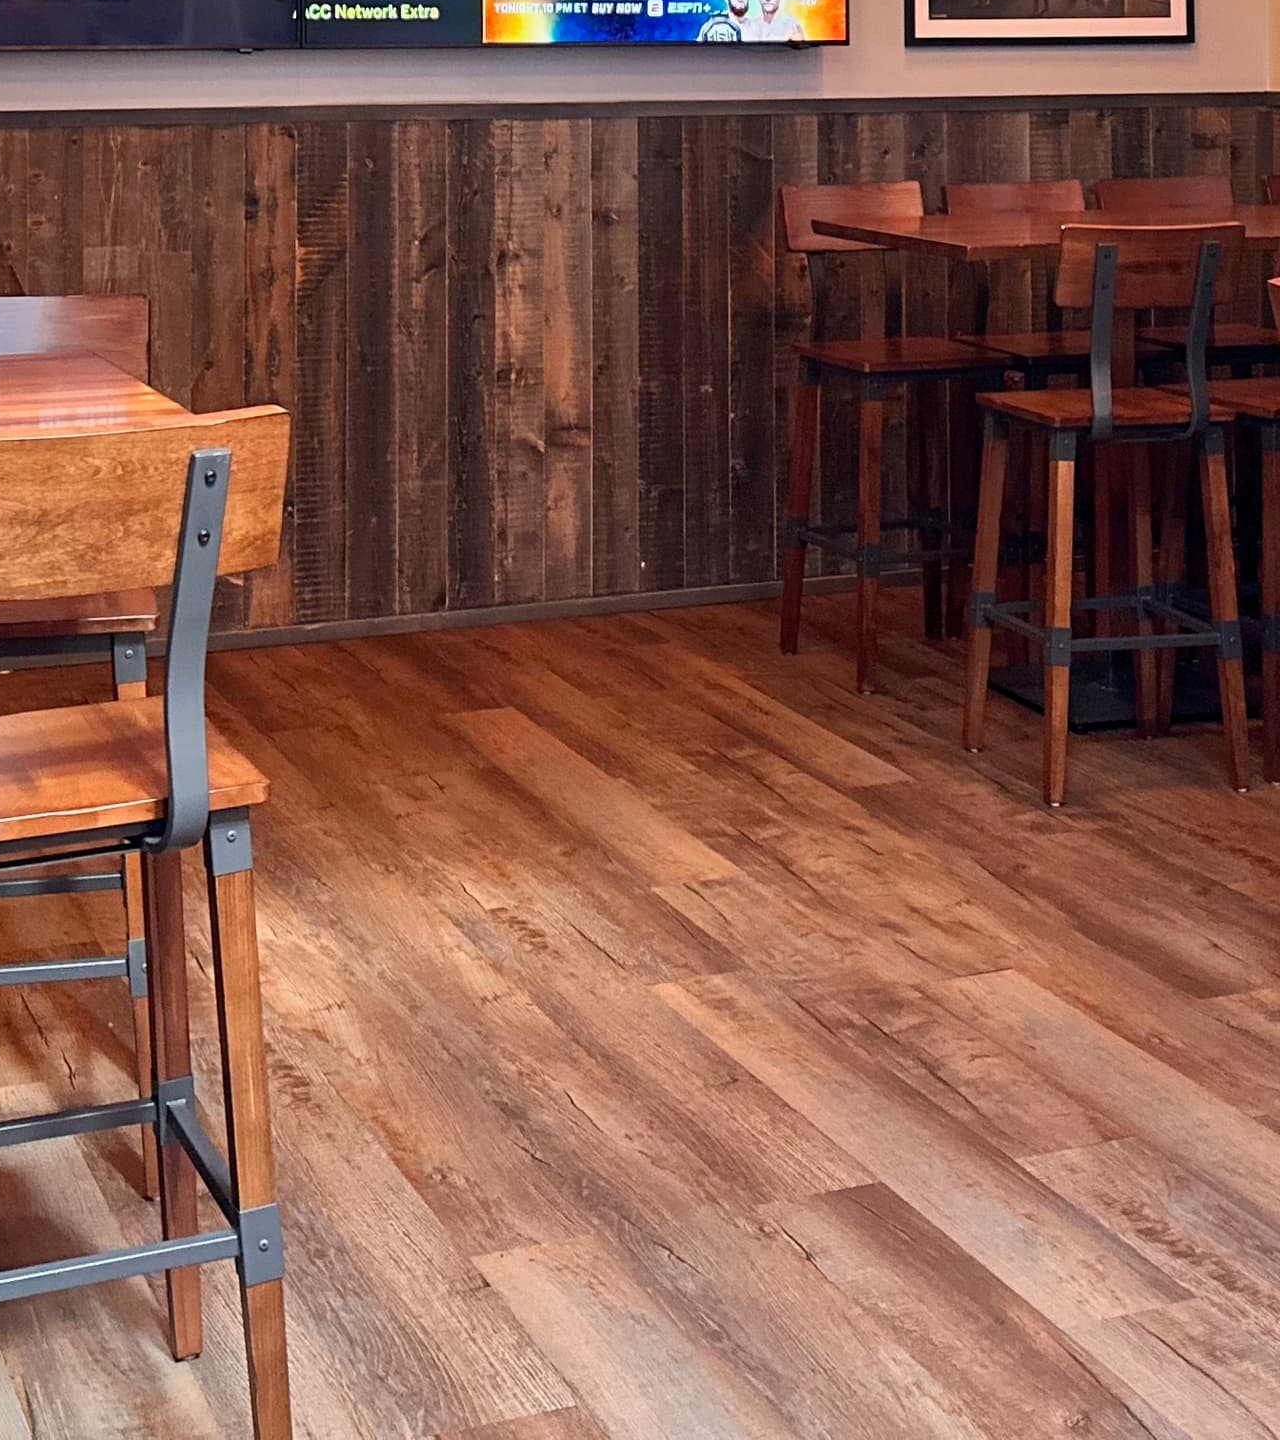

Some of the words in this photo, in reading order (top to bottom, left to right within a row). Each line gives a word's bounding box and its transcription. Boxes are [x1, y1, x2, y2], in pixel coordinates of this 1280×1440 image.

[334, 4, 398, 20] Network
[400, 4, 440, 20] Extra
[494, 3, 540, 14] TONIGHT
[543, 3, 554, 14] 10
[556, 3, 573, 14] PM
[574, 3, 588, 14] ET
[591, 3, 614, 14] BUY
[616, 3, 642, 14] NOW
[667, 2, 711, 14] ESPN+
